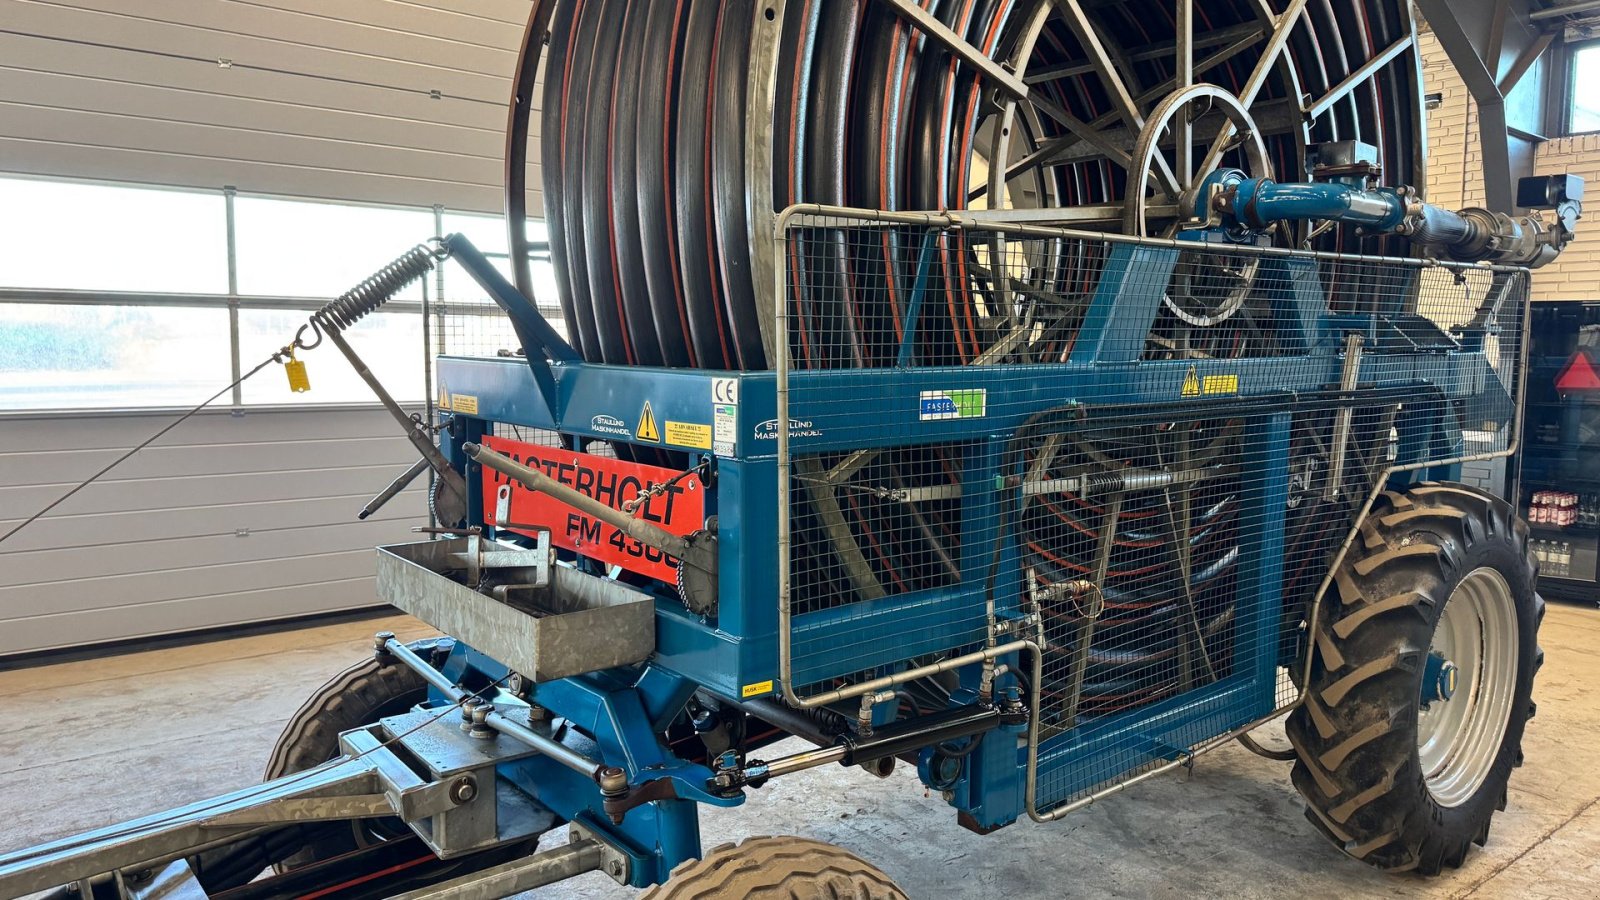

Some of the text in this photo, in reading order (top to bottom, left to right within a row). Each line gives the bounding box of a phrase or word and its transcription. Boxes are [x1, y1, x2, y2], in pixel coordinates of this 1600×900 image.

[766, 421, 813, 431] STLUND
[754, 430, 823, 440] MASKHANDEL
[566, 512, 602, 545] FM
